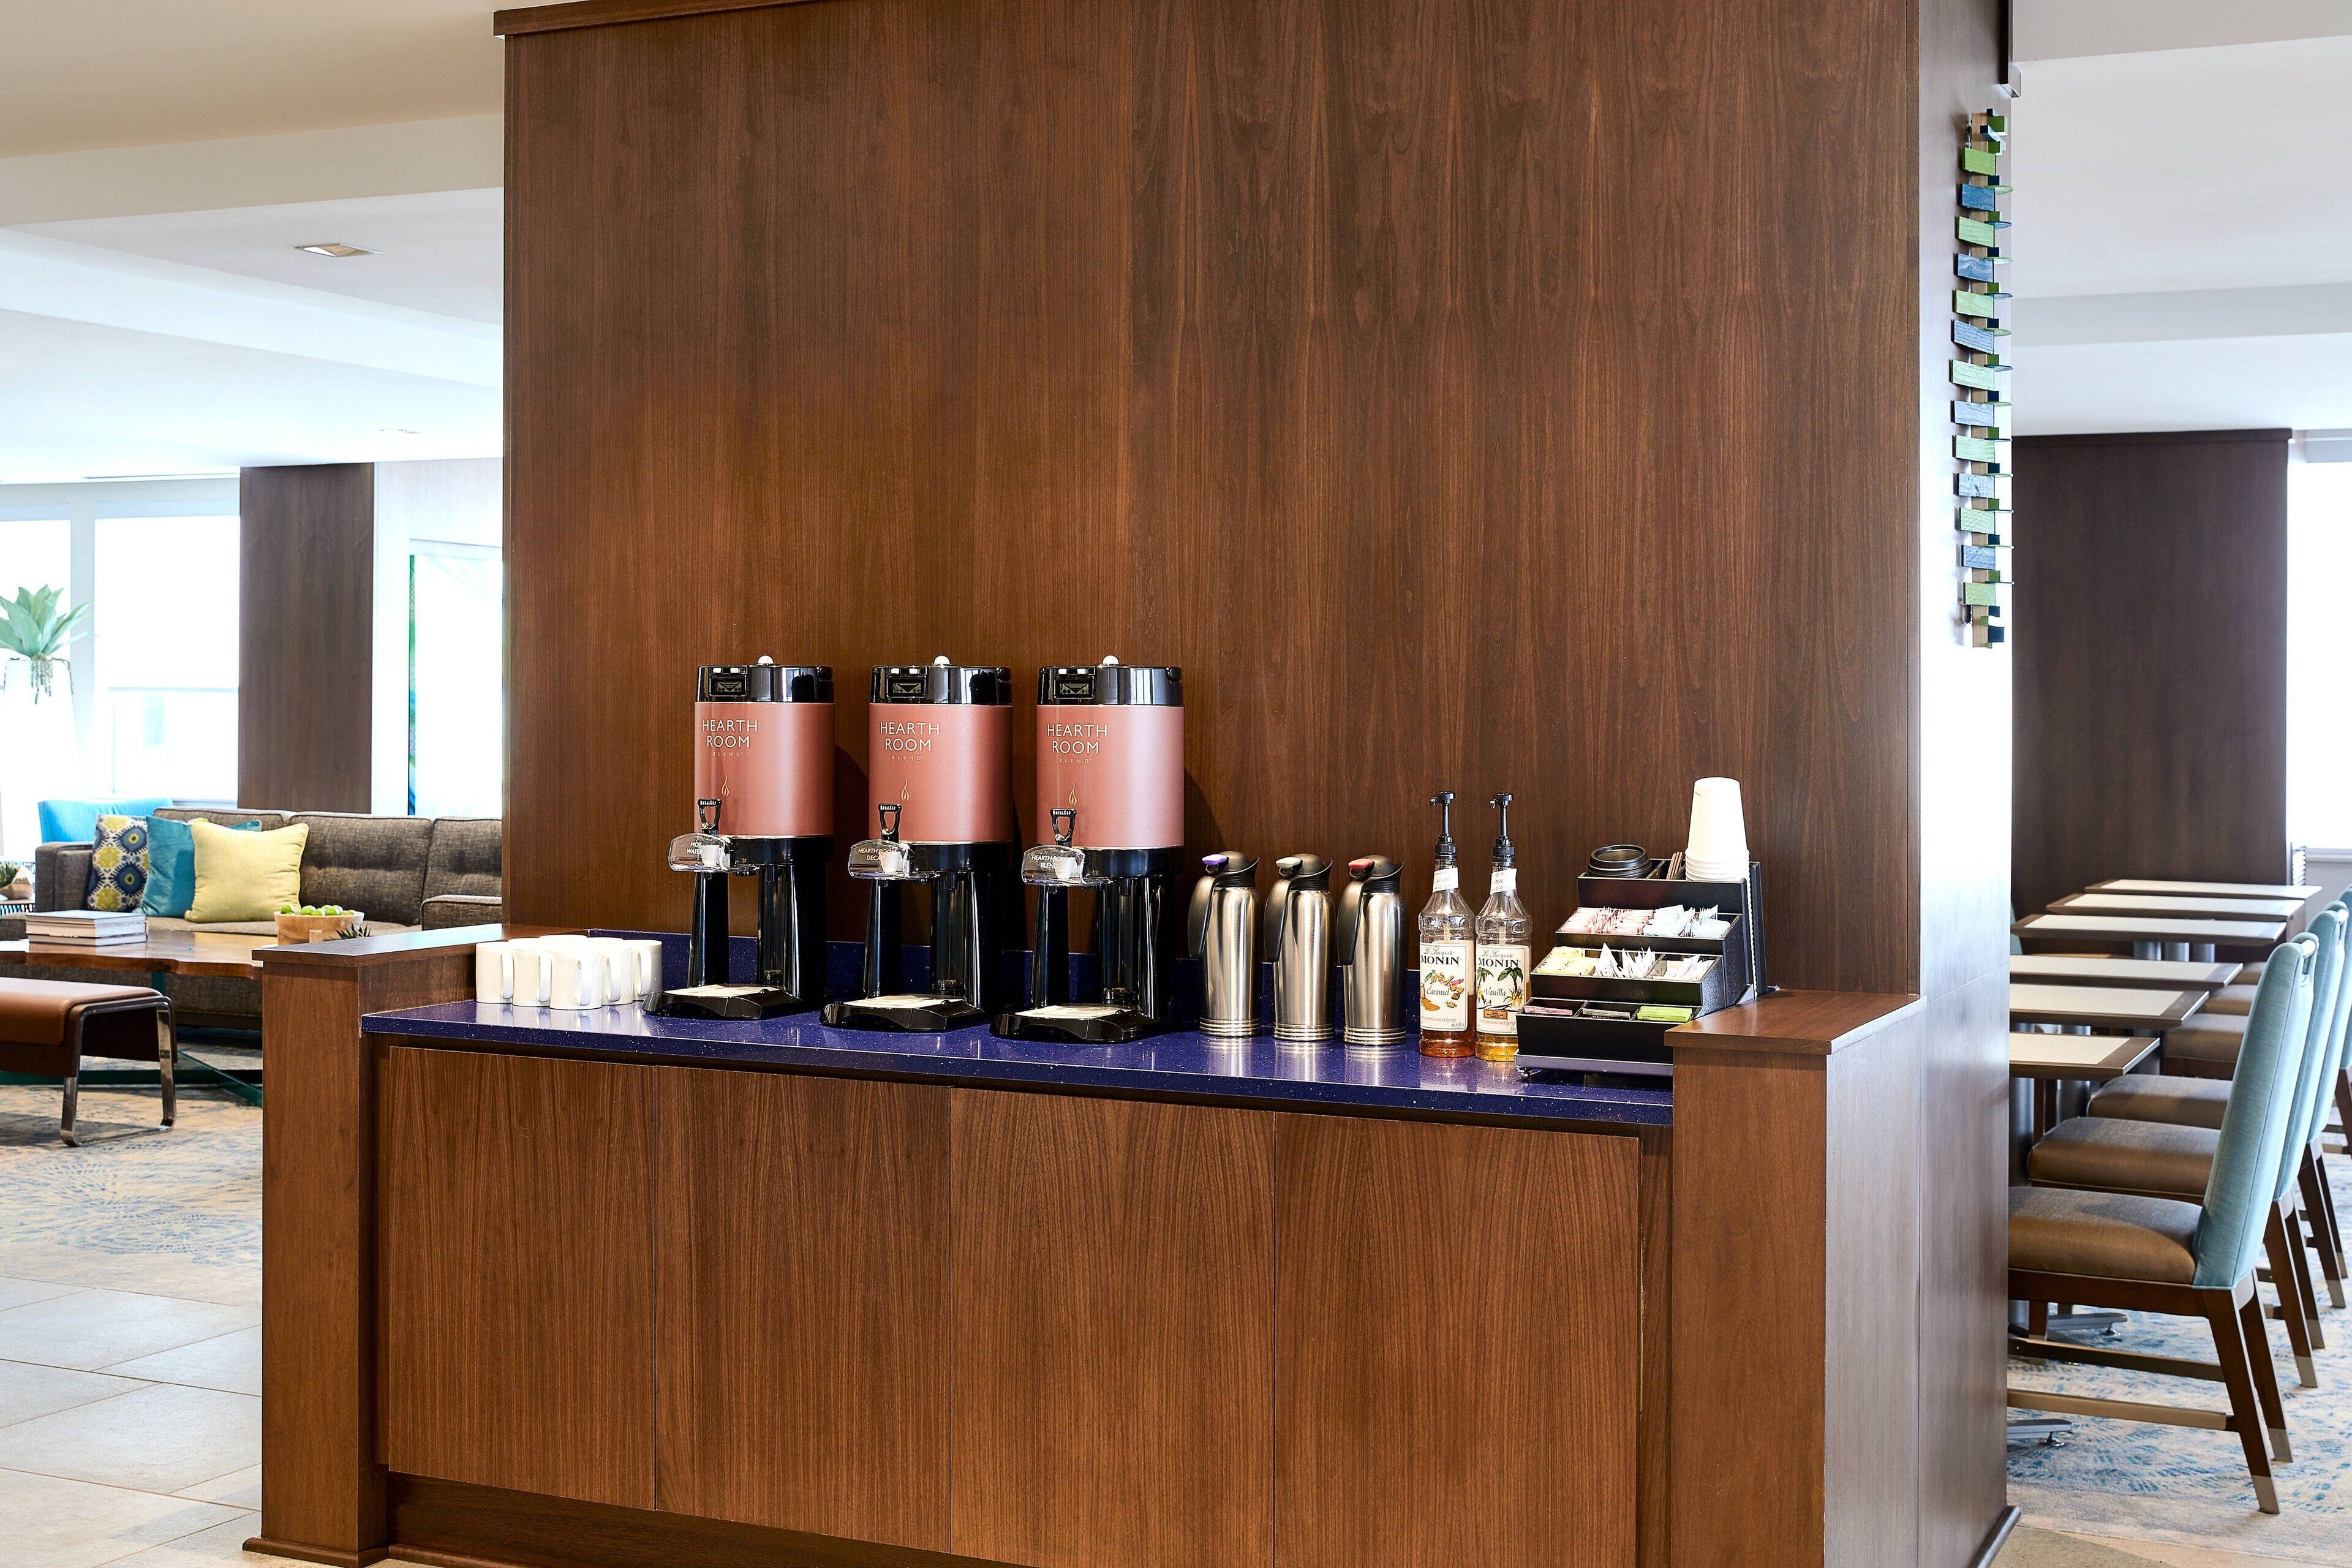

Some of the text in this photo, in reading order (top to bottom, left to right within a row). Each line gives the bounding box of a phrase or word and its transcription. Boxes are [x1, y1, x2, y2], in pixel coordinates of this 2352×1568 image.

[702, 719, 758, 733] HEARTH
[880, 722, 940, 736] HEARTH
[1047, 724, 1108, 737] HEARTH
[706, 734, 750, 748] ROOM
[884, 737, 932, 752] ROOM
[1052, 740, 1099, 755] ROOM
[1420, 955, 1460, 965] MONIN
[1478, 957, 1520, 967] MONIN
[1426, 986, 1450, 996] Caramel
[1483, 987, 1506, 997] Vanilla
